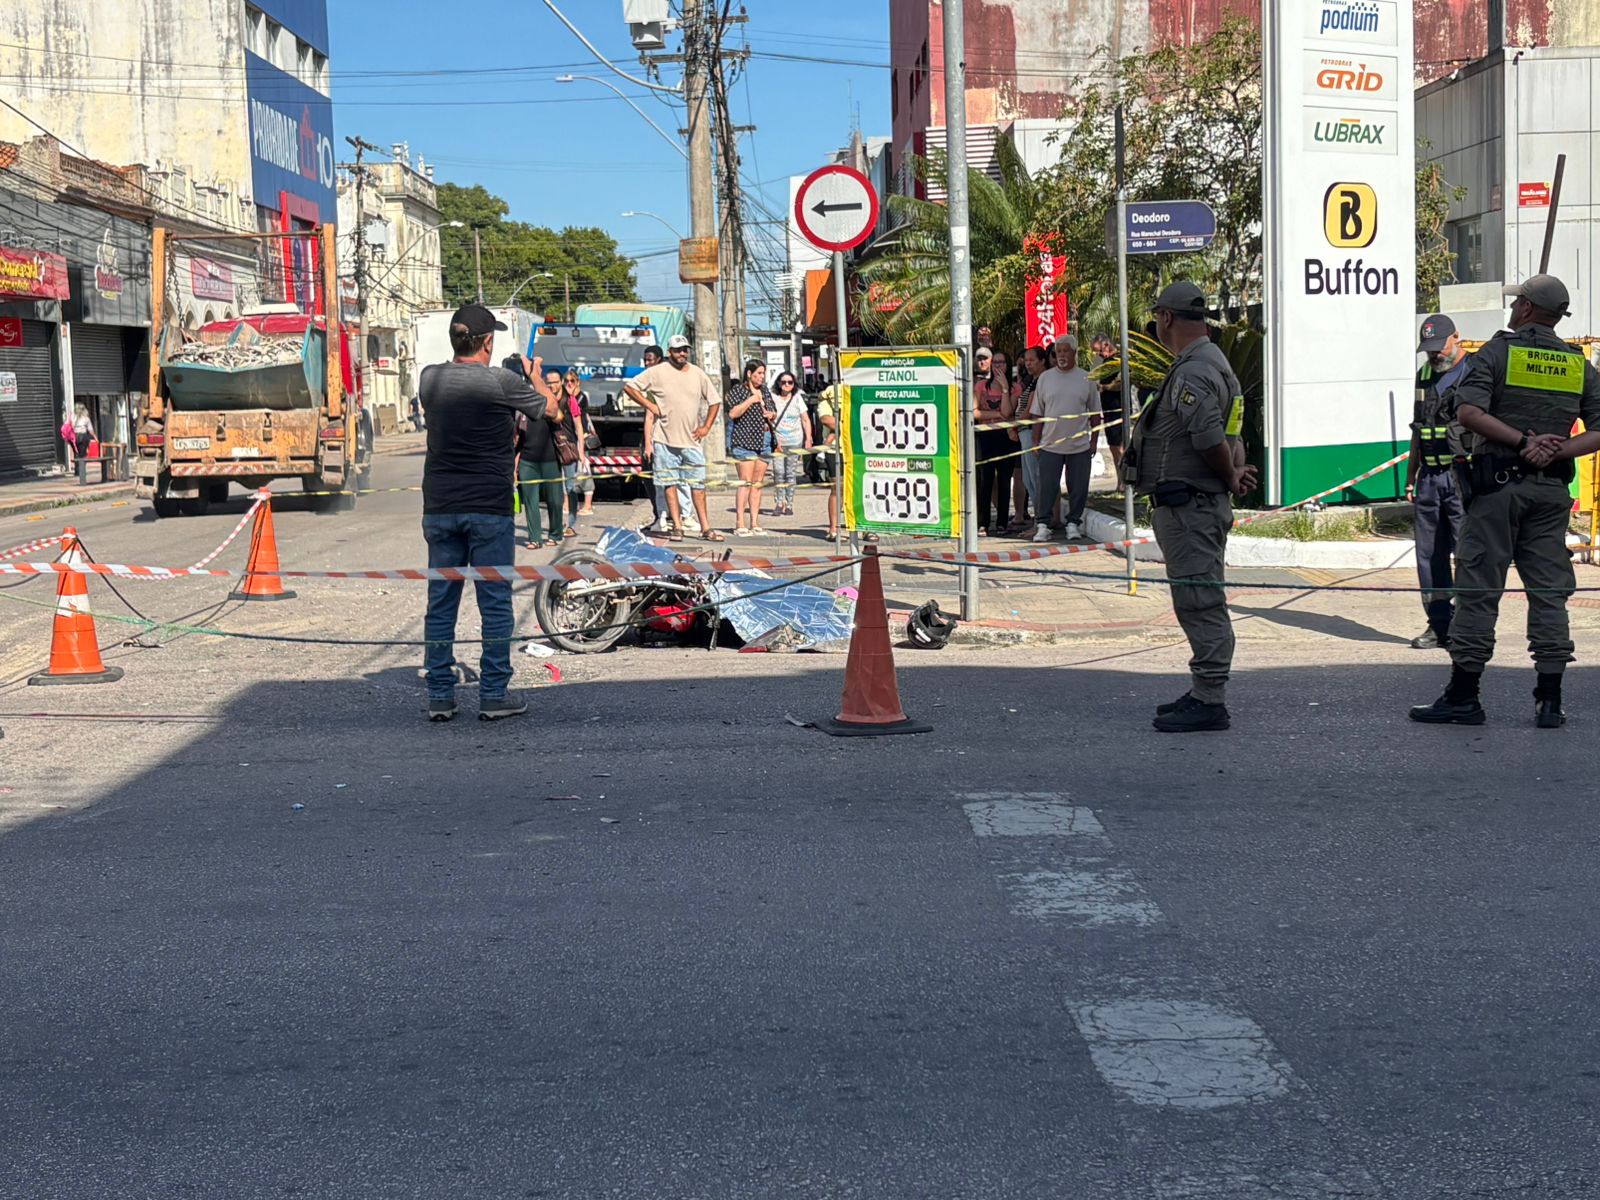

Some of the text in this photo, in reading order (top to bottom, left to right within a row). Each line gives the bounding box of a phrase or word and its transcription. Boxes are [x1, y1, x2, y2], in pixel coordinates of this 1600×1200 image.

[1320, 4, 1379, 34] podium
[1320, 58, 1353, 67] PETROBRAS
[1316, 64, 1383, 92] GRID
[1314, 121, 1385, 145] LUBRAX
[251, 97, 334, 189] PRIORIDADE 10
[1131, 212, 1170, 224] Deodoro
[1162, 229, 1181, 237] Deodoro
[1304, 258, 1398, 296] Buffon
[881, 357, 915, 367] PROMOÇÃO
[1527, 350, 1568, 364] BRIGADA
[878, 370, 919, 382] ETANOL
[1526, 363, 1567, 377] MILITAR
[875, 390, 921, 400] PREÇO ATUAL
[868, 460, 883, 468] COM
[885, 460, 890, 468] O
[891, 460, 905, 469] APP
